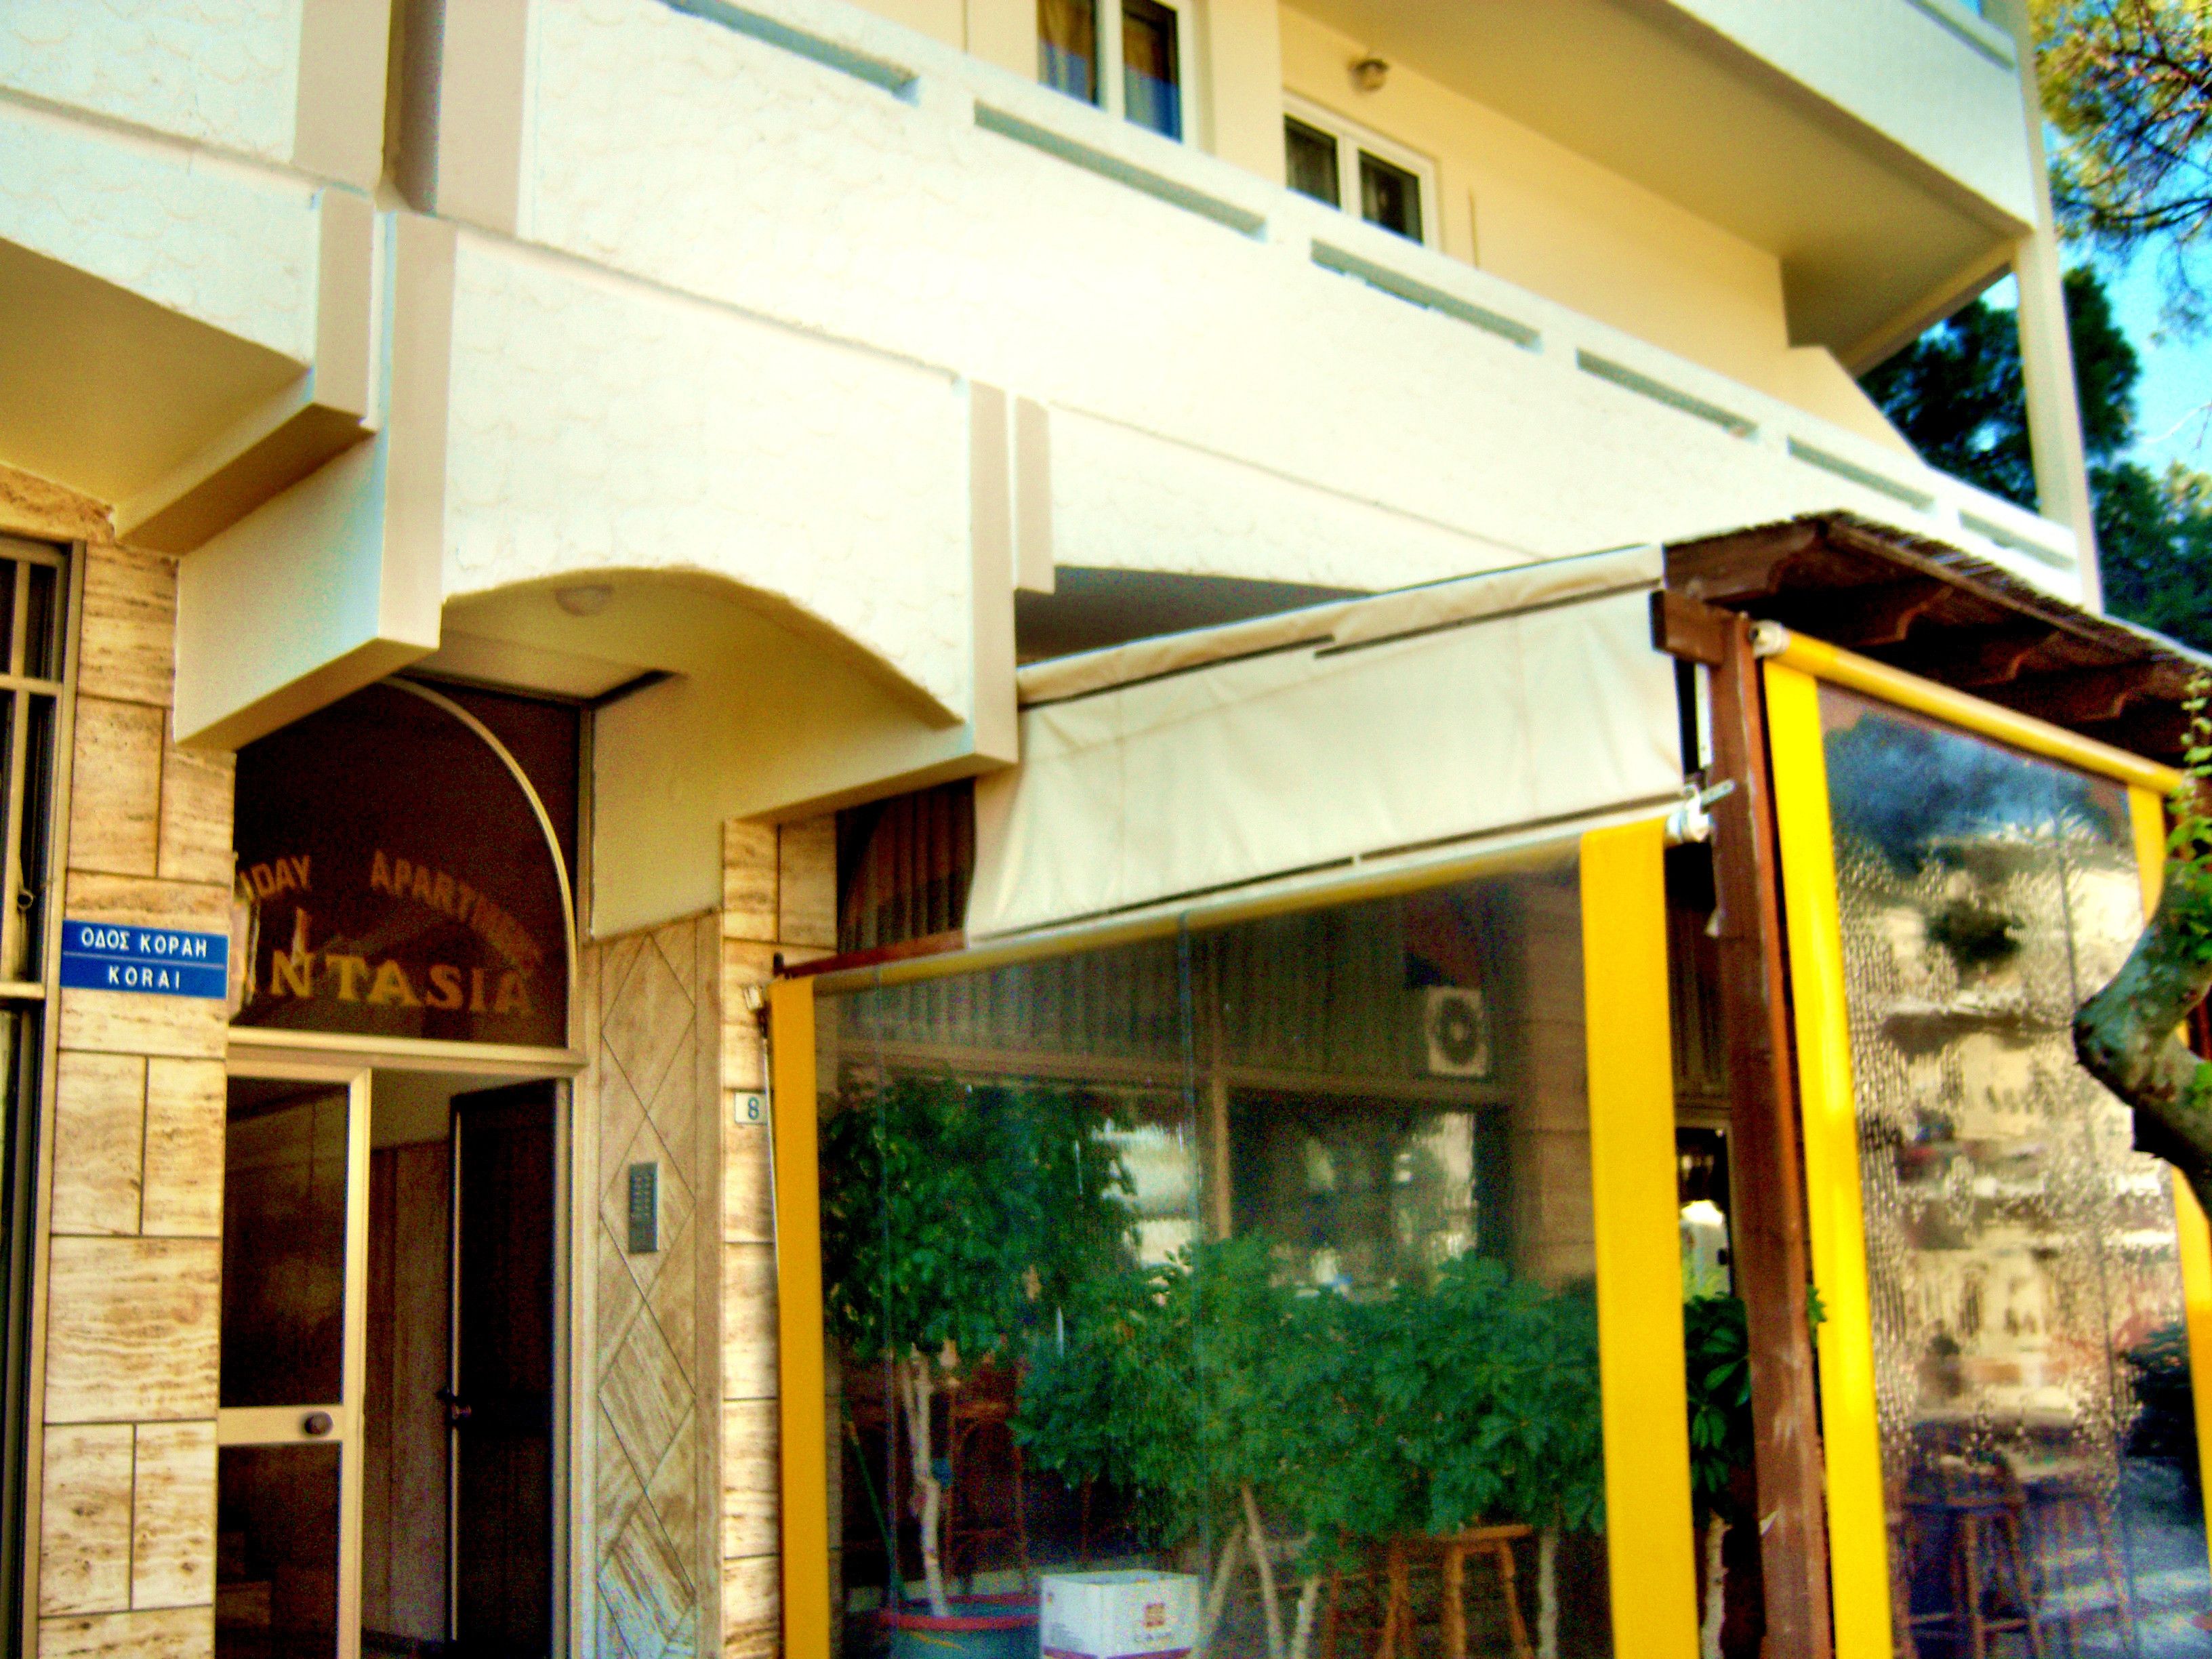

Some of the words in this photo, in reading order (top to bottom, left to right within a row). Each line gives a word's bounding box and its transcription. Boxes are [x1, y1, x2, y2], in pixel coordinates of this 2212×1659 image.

[81, 926, 131, 951] ΟΔΟΣ
[140, 932, 207, 958] ΚΟΡΑΗ
[108, 964, 181, 991] KORAI
[747, 1097, 760, 1120] 8
